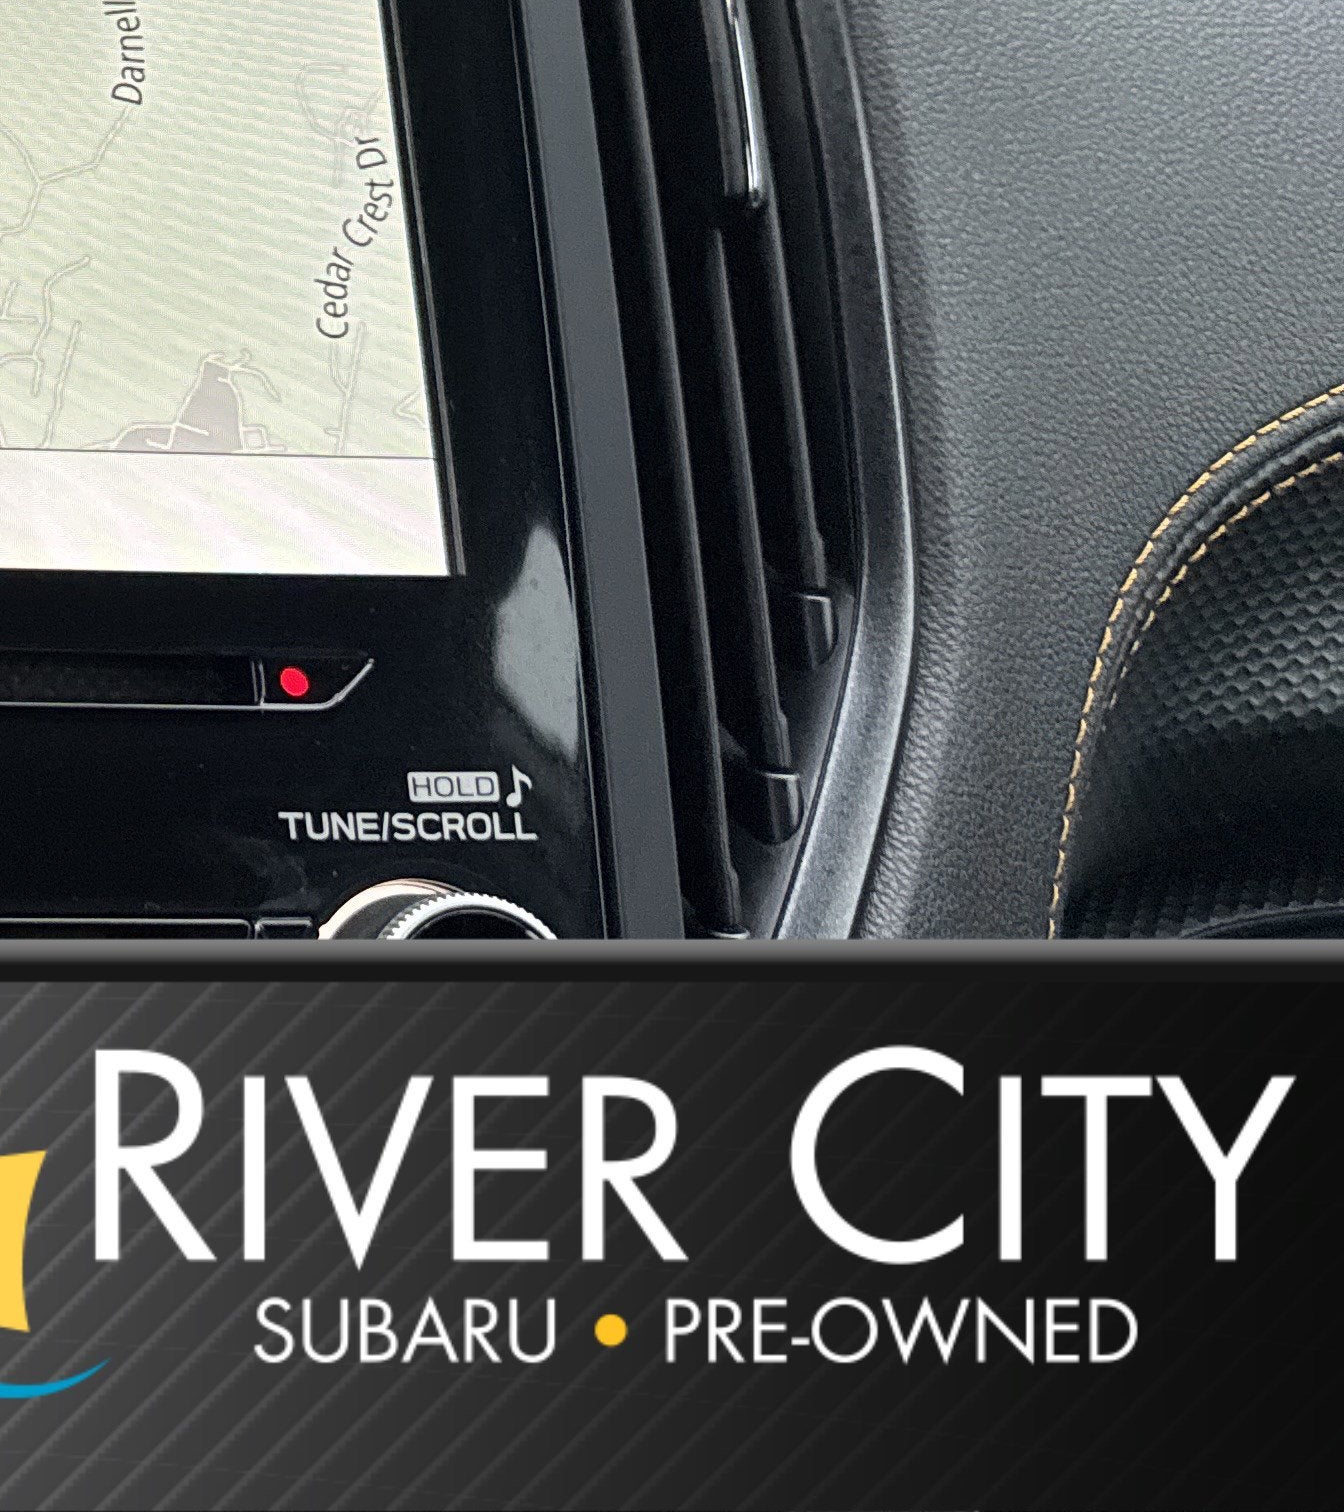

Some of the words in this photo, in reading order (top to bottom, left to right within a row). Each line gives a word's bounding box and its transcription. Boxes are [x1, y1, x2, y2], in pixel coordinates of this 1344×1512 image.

[104, 0, 145, 106] Darnell
[355, 136, 388, 170] Dr
[342, 176, 395, 247] Crest
[315, 245, 355, 340] Cedar
[411, 775, 497, 799] HOLD
[278, 811, 538, 842] TUNE/SCROLL
